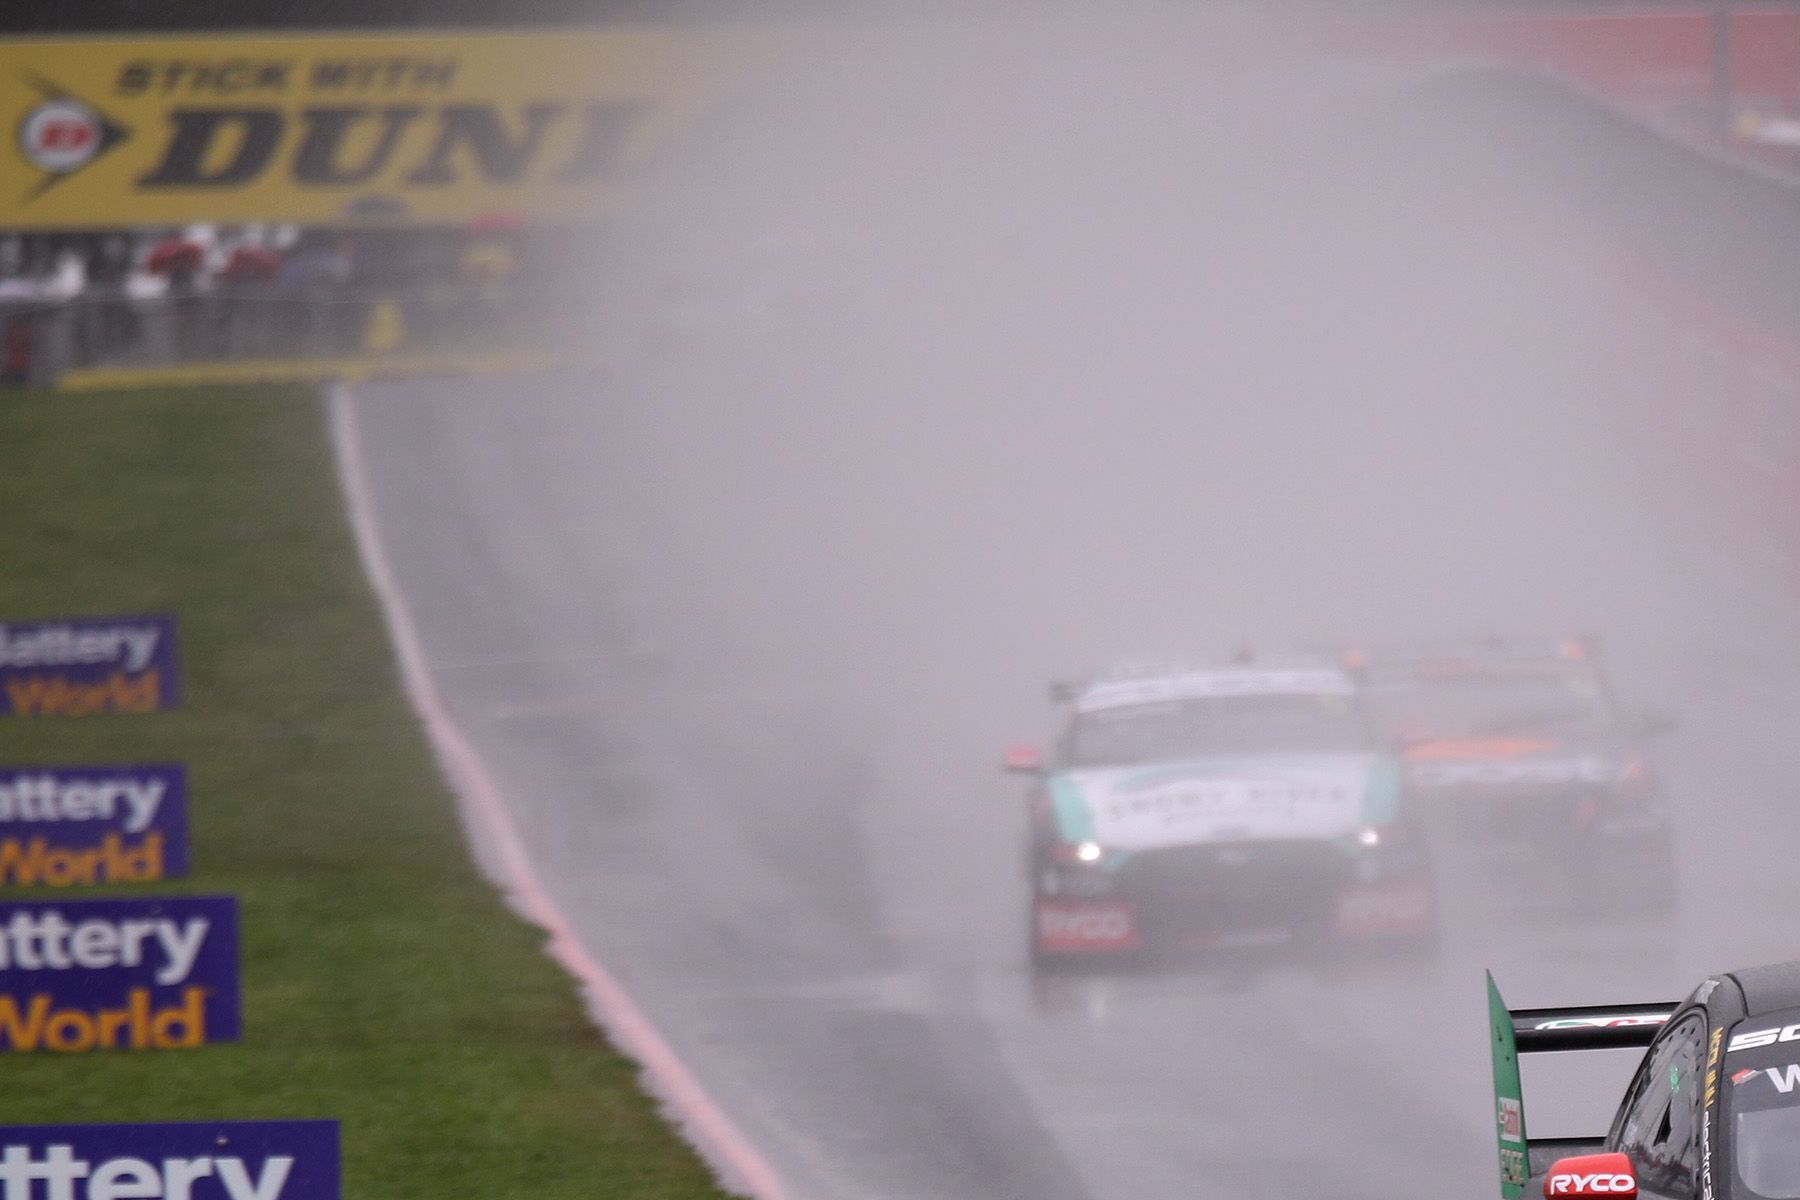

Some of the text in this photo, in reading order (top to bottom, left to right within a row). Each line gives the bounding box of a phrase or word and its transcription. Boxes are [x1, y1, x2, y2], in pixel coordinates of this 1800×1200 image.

[114, 55, 459, 96] STICK WITH
[131, 101, 661, 191] DUNL
[0, 625, 161, 673] attery
[1550, 1174, 1635, 1196] RYCO
